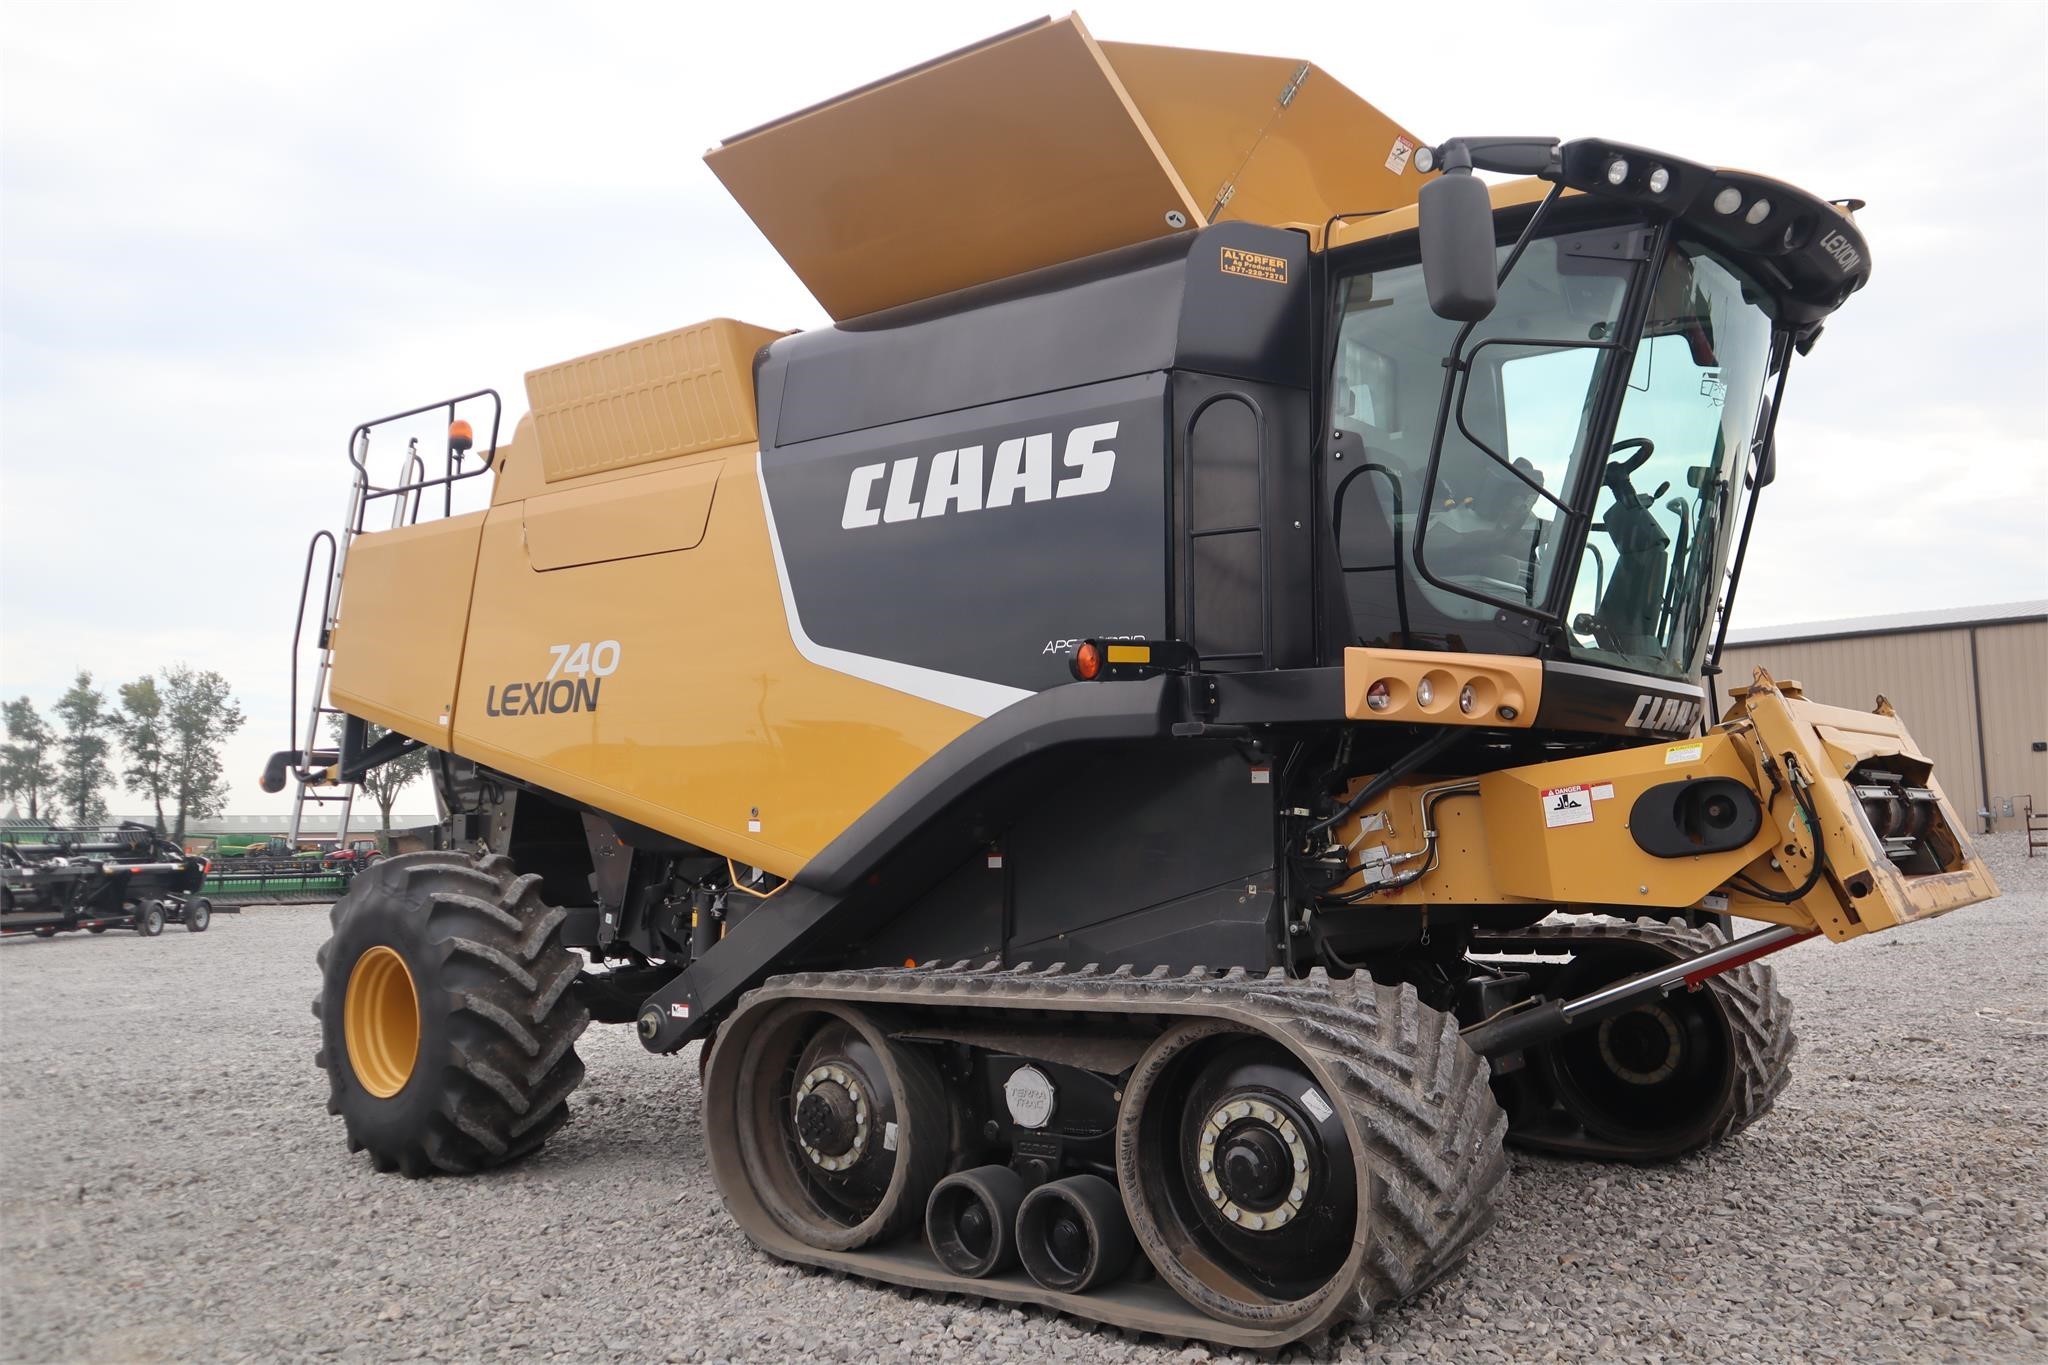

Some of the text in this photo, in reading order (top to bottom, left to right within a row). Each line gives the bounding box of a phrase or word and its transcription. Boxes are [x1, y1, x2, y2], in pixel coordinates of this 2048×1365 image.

[1224, 250, 1284, 269] ALTORFER
[1244, 261, 1276, 273] Products
[1820, 229, 1860, 272] LEXION
[841, 420, 1120, 530] CLAAS
[545, 639, 621, 681] 740
[486, 677, 601, 717] LEXION
[1624, 694, 1701, 734] CLAAS
[1555, 785, 1582, 795] DANGER
